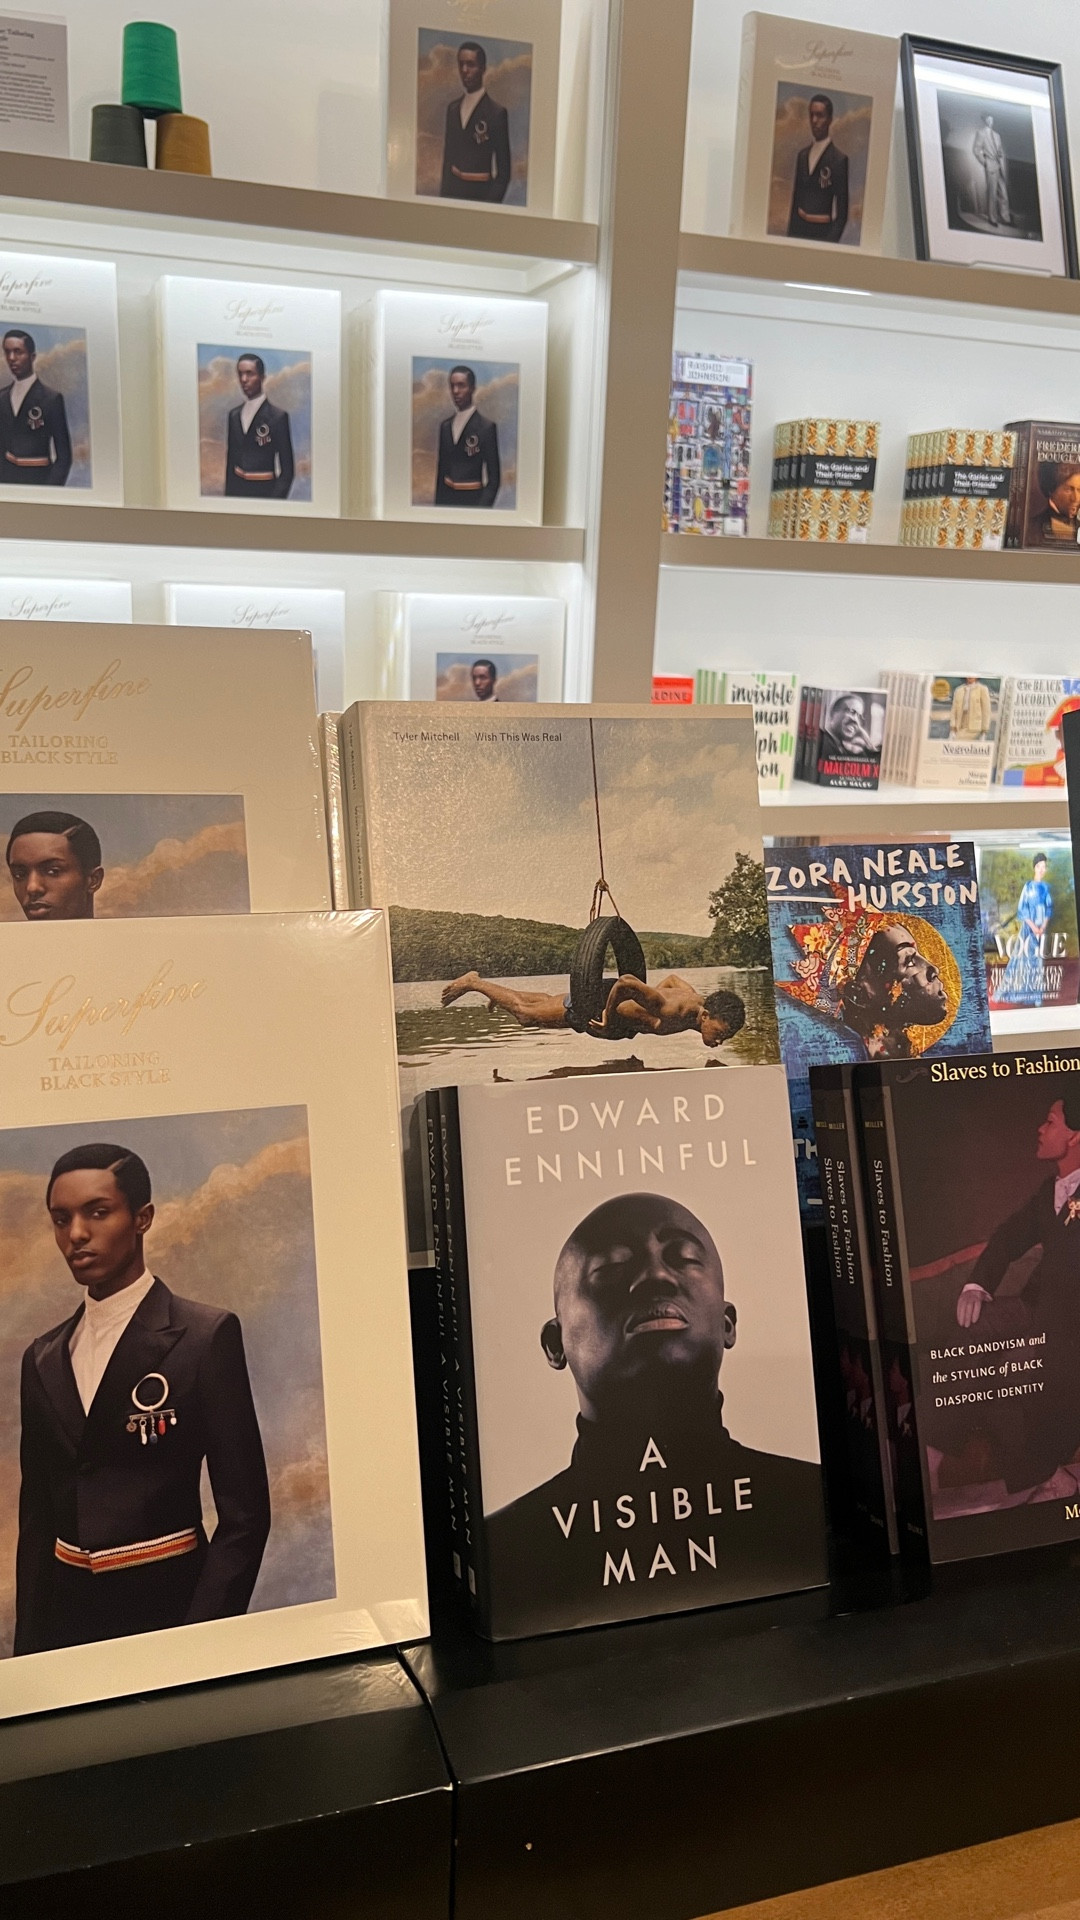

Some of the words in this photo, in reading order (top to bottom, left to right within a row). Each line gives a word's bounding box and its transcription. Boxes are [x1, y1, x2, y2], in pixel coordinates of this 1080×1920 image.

[651, 690, 688, 701] LDINE
[731, 682, 794, 706] invisible
[755, 710, 789, 725] man
[8, 735, 108, 749] TAILORING
[393, 731, 418, 743] Tyler
[420, 731, 460, 742] Mitchell
[475, 731, 498, 742] Wish
[499, 731, 520, 742] This
[521, 732, 540, 742] Was
[542, 732, 562, 742] Real
[943, 743, 990, 756] Negroland
[1, 750, 63, 765] BLACK
[64, 751, 118, 765] STYLE
[823, 760, 871, 777] MALCOLM
[873, 764, 880, 778] X
[765, 857, 852, 891] ZORA
[863, 844, 965, 879] NEALE
[847, 880, 978, 912] HURSTON
[994, 932, 1068, 959] VOGUE
[0, 959, 207, 1051] Superfine
[48, 1050, 160, 1071] TAILORING
[931, 1062, 987, 1082] Slaves
[991, 1062, 1010, 1077] to
[1014, 1054, 1080, 1076] Fashion
[40, 1073, 104, 1091] BLACK
[110, 1068, 171, 1087] STYLE
[526, 1094, 724, 1134] EDWARD
[428, 1117, 438, 1211] EDWARD
[441, 1113, 450, 1211] EDWARD
[505, 1139, 757, 1186] ENNINFUL
[824, 1157, 834, 1201] Slaves
[836, 1160, 847, 1205] Slaves
[873, 1159, 884, 1204] Slaves
[829, 1204, 836, 1220] to
[842, 1209, 849, 1224] to
[879, 1208, 886, 1225] to
[831, 1223, 842, 1278] Fashion
[844, 1228, 855, 1285] Fashion
[881, 1229, 893, 1287] Fashion
[930, 1346, 965, 1360] BLACK
[969, 1338, 1026, 1355] DANDYISM
[1028, 1332, 1046, 1346] and
[932, 1371, 948, 1384] the
[951, 1365, 996, 1381] STYLING
[999, 1361, 1009, 1377] of
[1011, 1359, 1044, 1373] BLACK
[935, 1390, 994, 1408] DIASPORIC
[997, 1382, 1044, 1398] IDENTITY
[639, 1436, 667, 1472] A
[551, 1477, 753, 1539] VISIBLE
[603, 1535, 717, 1586] MAN
